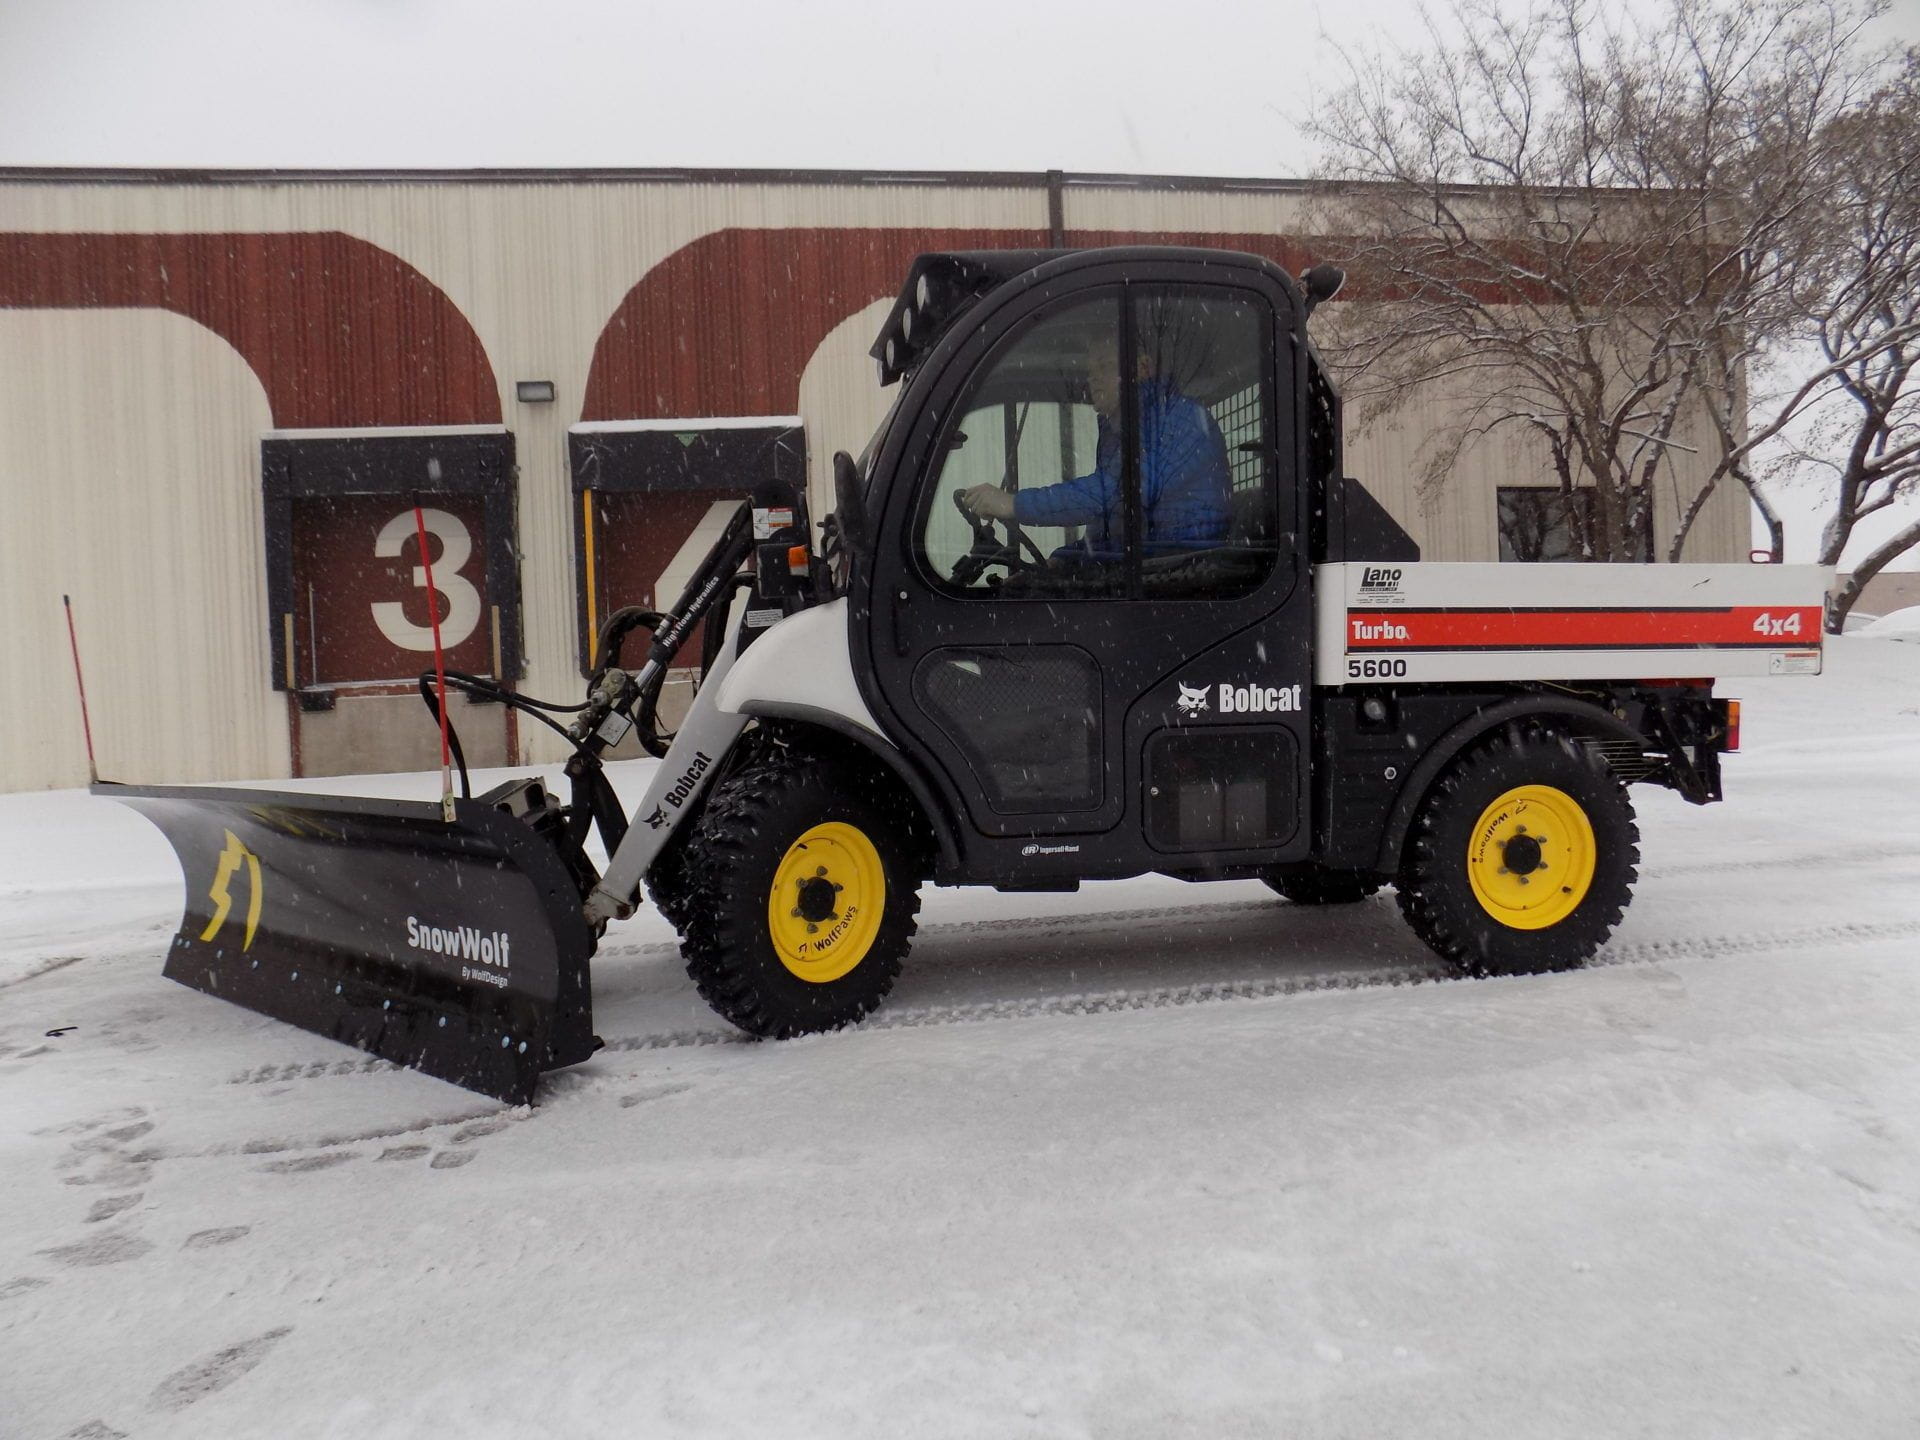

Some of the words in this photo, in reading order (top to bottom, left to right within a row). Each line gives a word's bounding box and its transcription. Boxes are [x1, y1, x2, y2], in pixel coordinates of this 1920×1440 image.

[370, 508, 481, 652] 3
[1361, 567, 1402, 587] Lano
[662, 629, 679, 648] High
[675, 612, 692, 631] Flow
[688, 576, 720, 613] Hydraulics
[1753, 613, 1800, 636] 4x4
[1352, 620, 1406, 640] Turbo
[1348, 659, 1407, 678] 5600
[1219, 683, 1302, 713] Bobcat
[664, 751, 713, 809] Bobcat
[406, 915, 510, 968] SnowWolf
[814, 905, 857, 951] WolfPaws
[462, 966, 471, 980] By
[471, 968, 509, 989] WolfDesign
